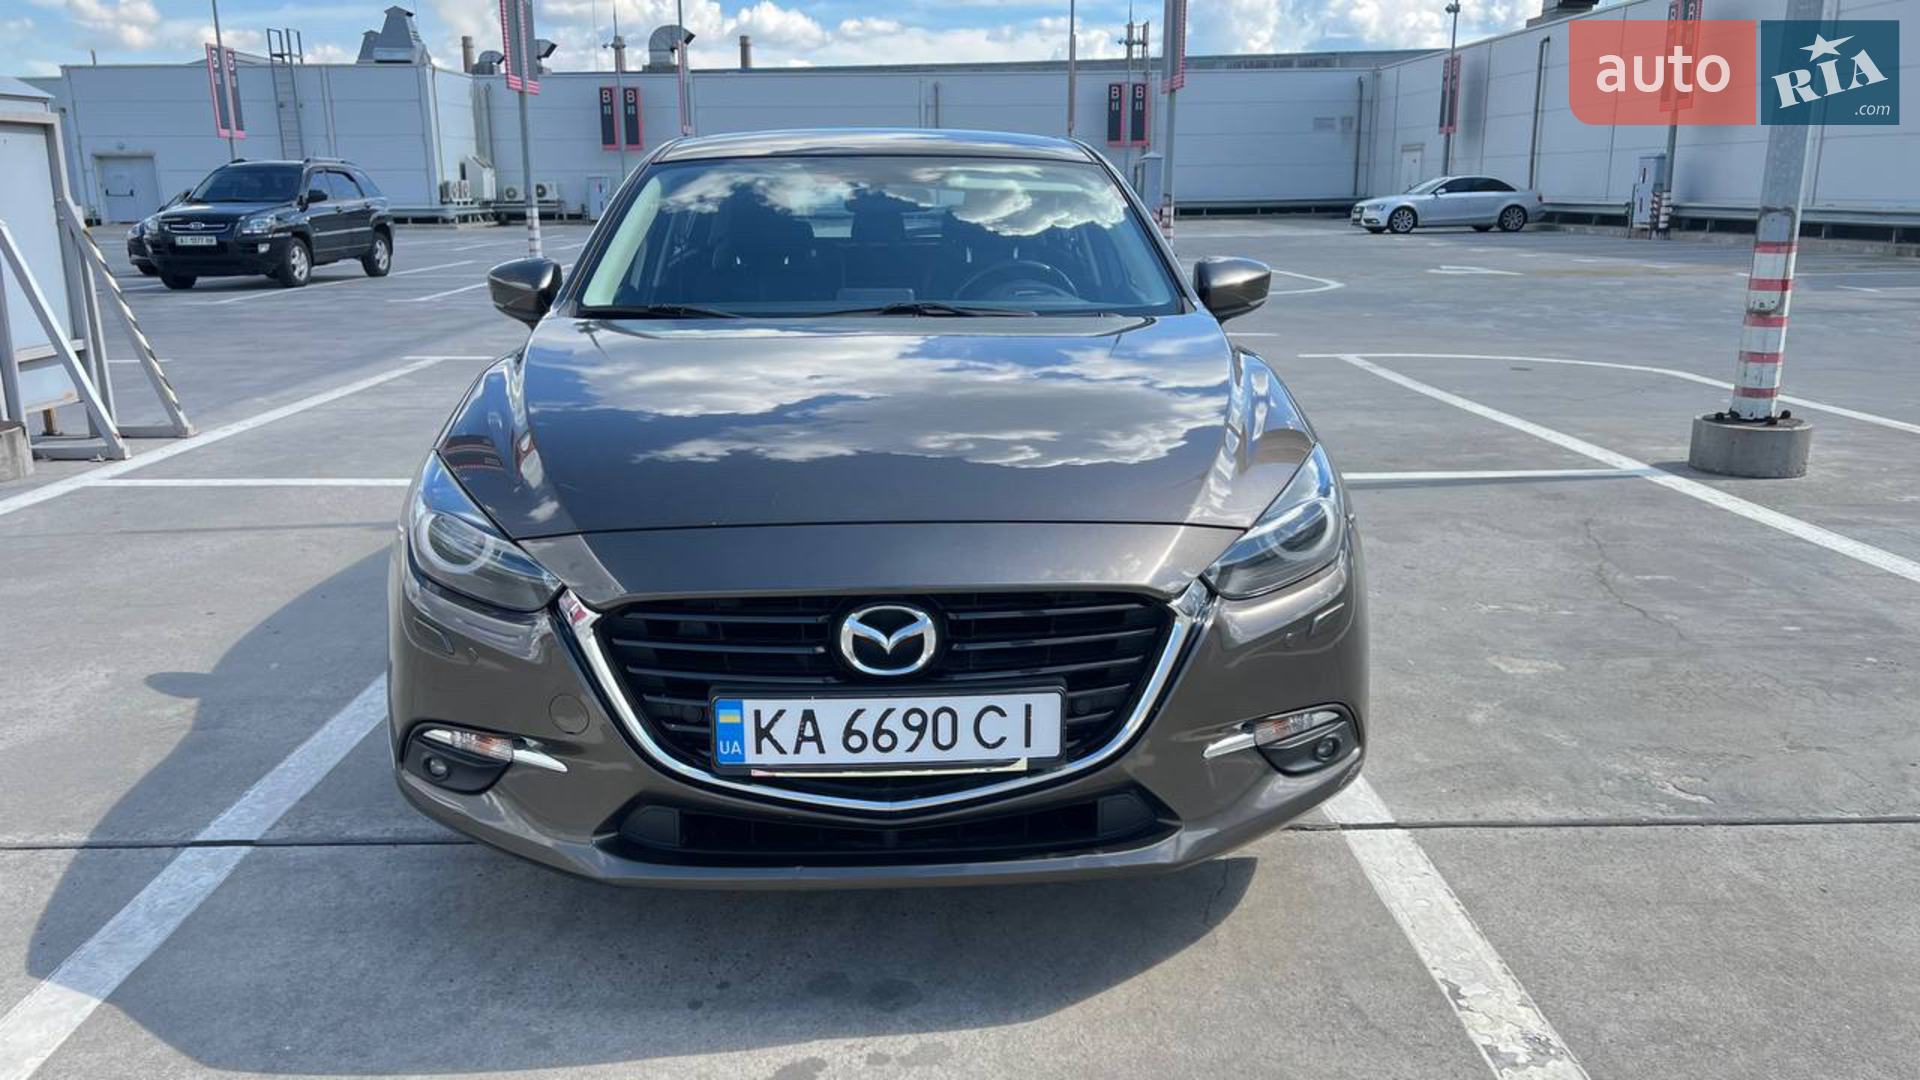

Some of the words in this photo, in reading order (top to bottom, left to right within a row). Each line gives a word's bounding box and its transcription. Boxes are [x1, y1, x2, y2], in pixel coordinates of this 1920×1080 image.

[602, 89, 611, 103] B
[626, 89, 635, 103] B
[1111, 86, 1120, 99] B
[1136, 86, 1144, 98] B
[753, 708, 826, 755] KA
[842, 705, 958, 754] 6690
[719, 740, 742, 755] UA
